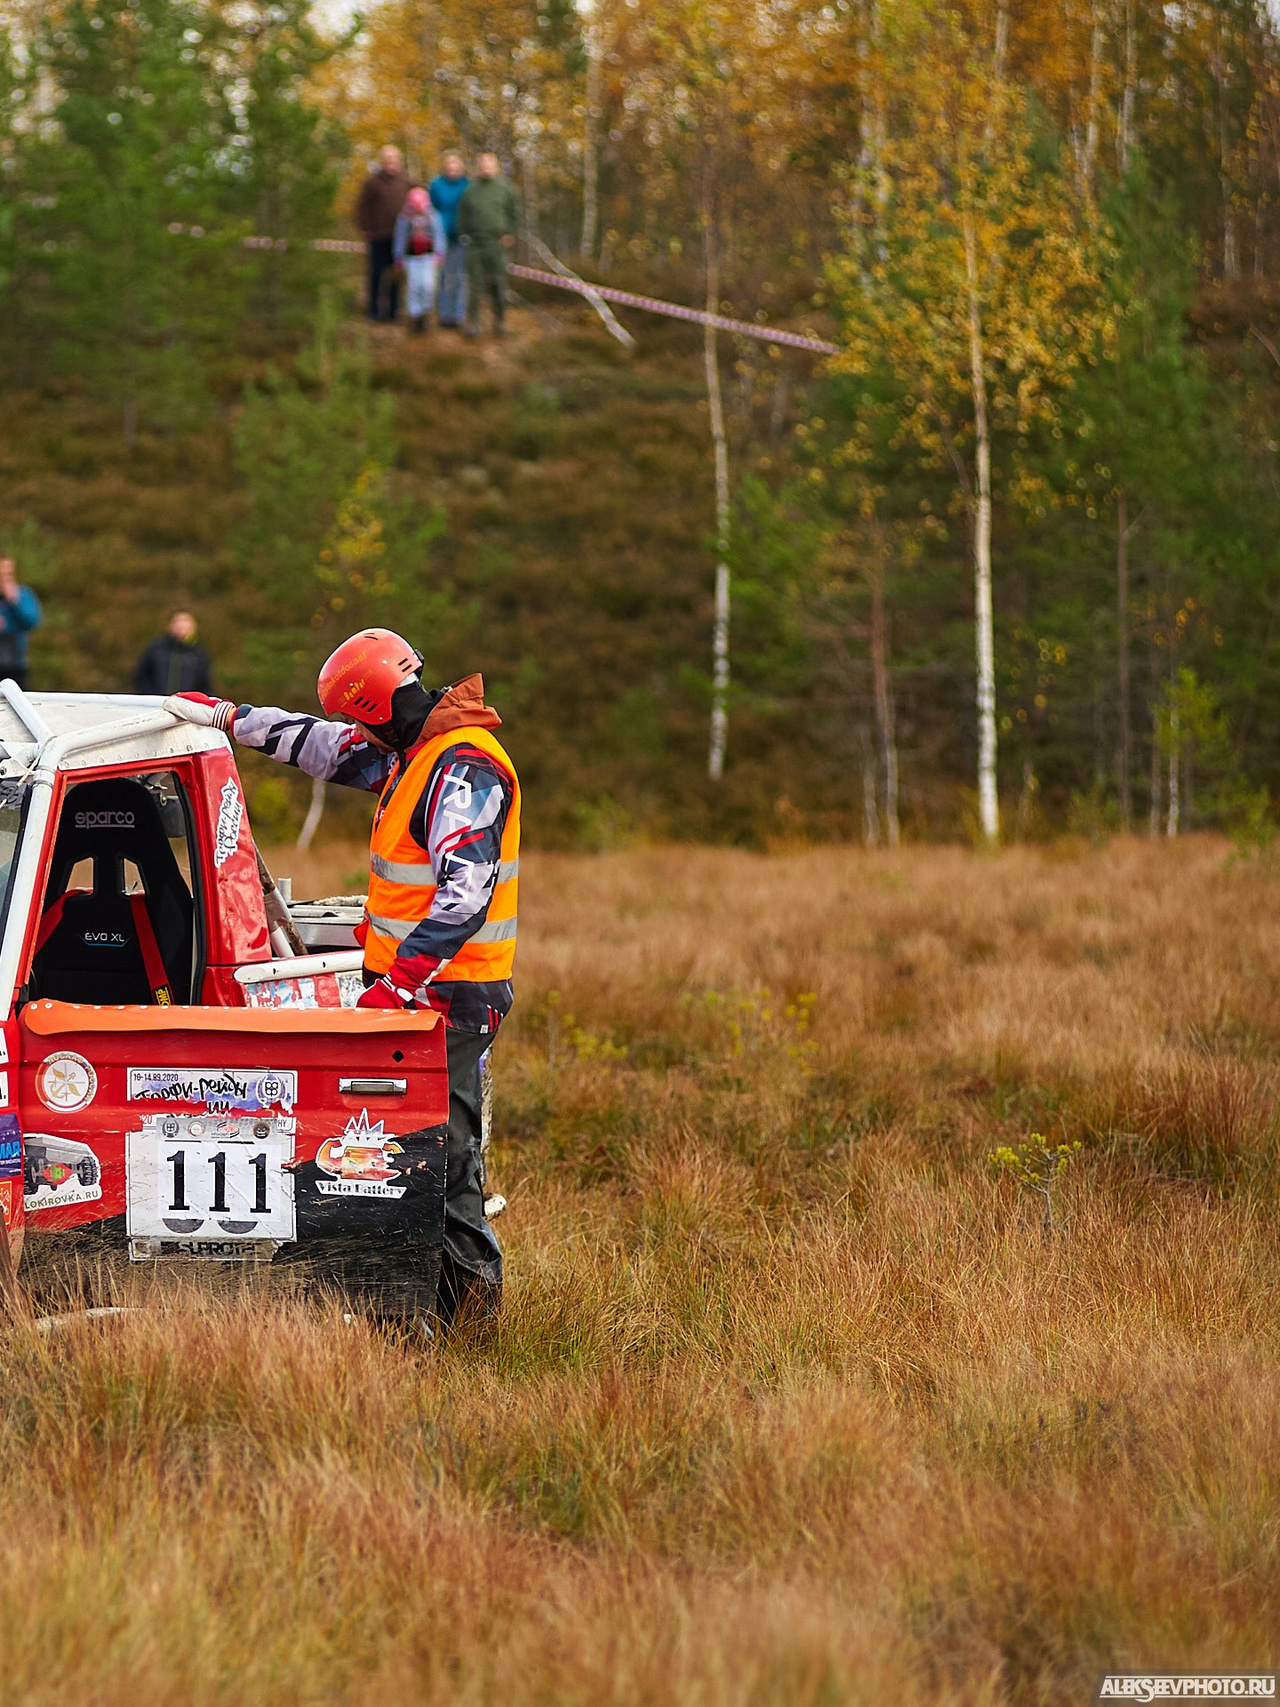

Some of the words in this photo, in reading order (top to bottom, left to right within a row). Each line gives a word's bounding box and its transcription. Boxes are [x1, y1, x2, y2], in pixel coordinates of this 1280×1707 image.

[75, 811, 135, 828] sparco
[84, 932, 108, 942] EVO
[111, 933, 125, 942] XL
[166, 1150, 272, 1214] 111
[317, 1181, 351, 1191] Vista
[354, 1184, 405, 1195] Battery
[24, 1190, 99, 1209] LOKIROVKA.RU
